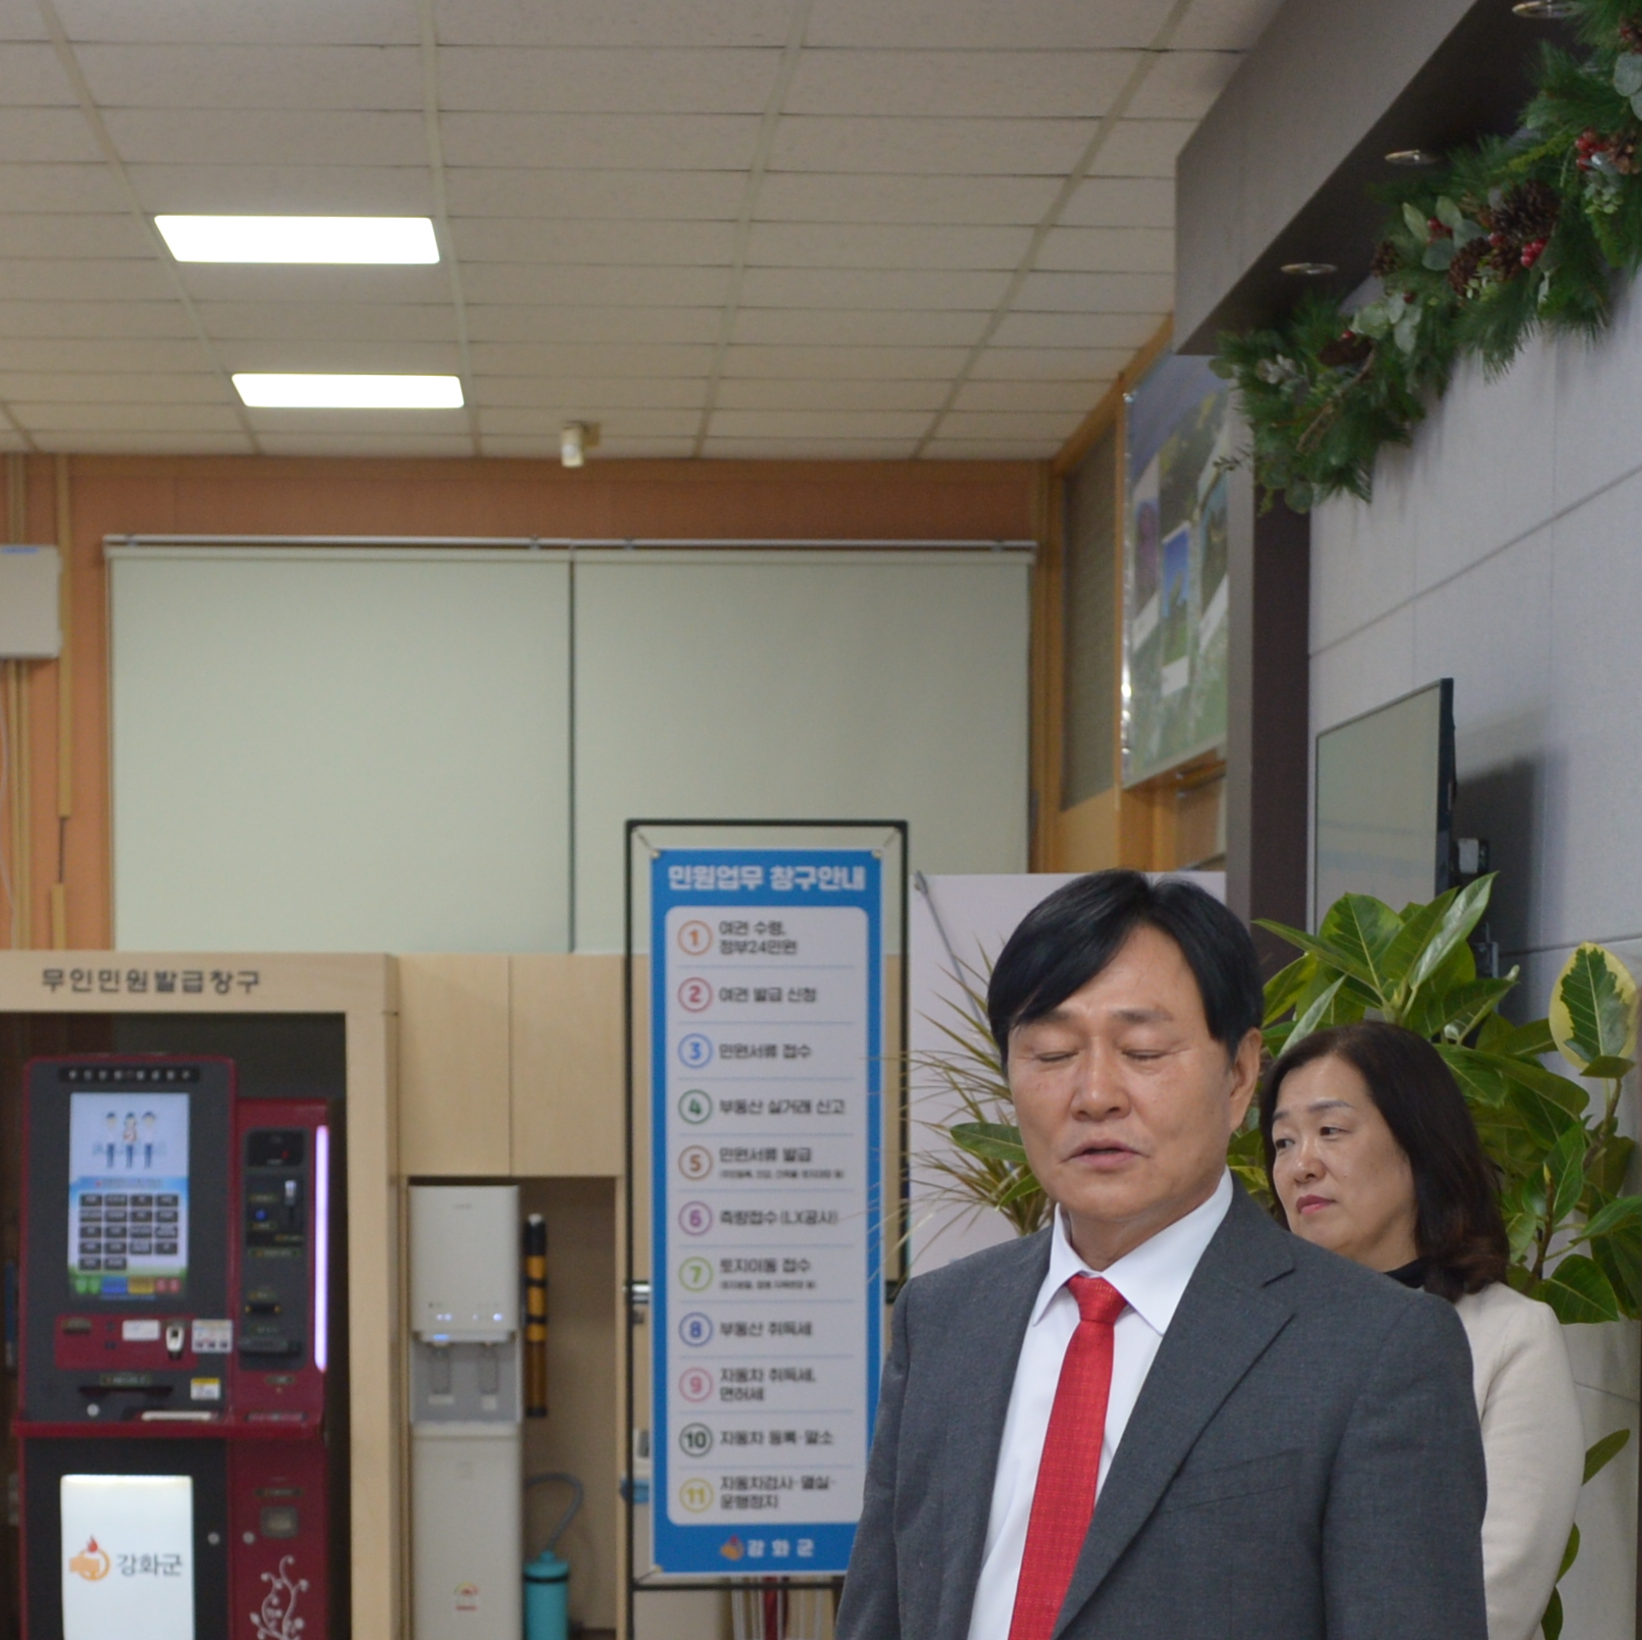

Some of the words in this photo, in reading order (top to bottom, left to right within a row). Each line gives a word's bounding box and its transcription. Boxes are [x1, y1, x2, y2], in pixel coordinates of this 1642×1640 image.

[668, 864, 764, 891] 민원업무
[769, 865, 866, 892] 창구안내
[42, 967, 260, 994] 무인민원발급창구
[719, 1043, 777, 1059] 민원서류
[782, 1043, 812, 1059] 접수
[719, 1098, 764, 1115] 부동산
[768, 1098, 812, 1115] 실거래
[816, 1098, 846, 1115] 신고
[719, 1147, 777, 1162] 민원서류
[782, 1147, 812, 1162] 발급
[720, 1258, 776, 1274] 토지이동
[782, 1258, 811, 1274] 접수
[720, 1321, 764, 1337] 부동산
[768, 1321, 813, 1337] 취득세
[720, 1367, 764, 1383] 자동차
[720, 1430, 764, 1446] 자동차
[116, 1553, 183, 1577] 강화군
